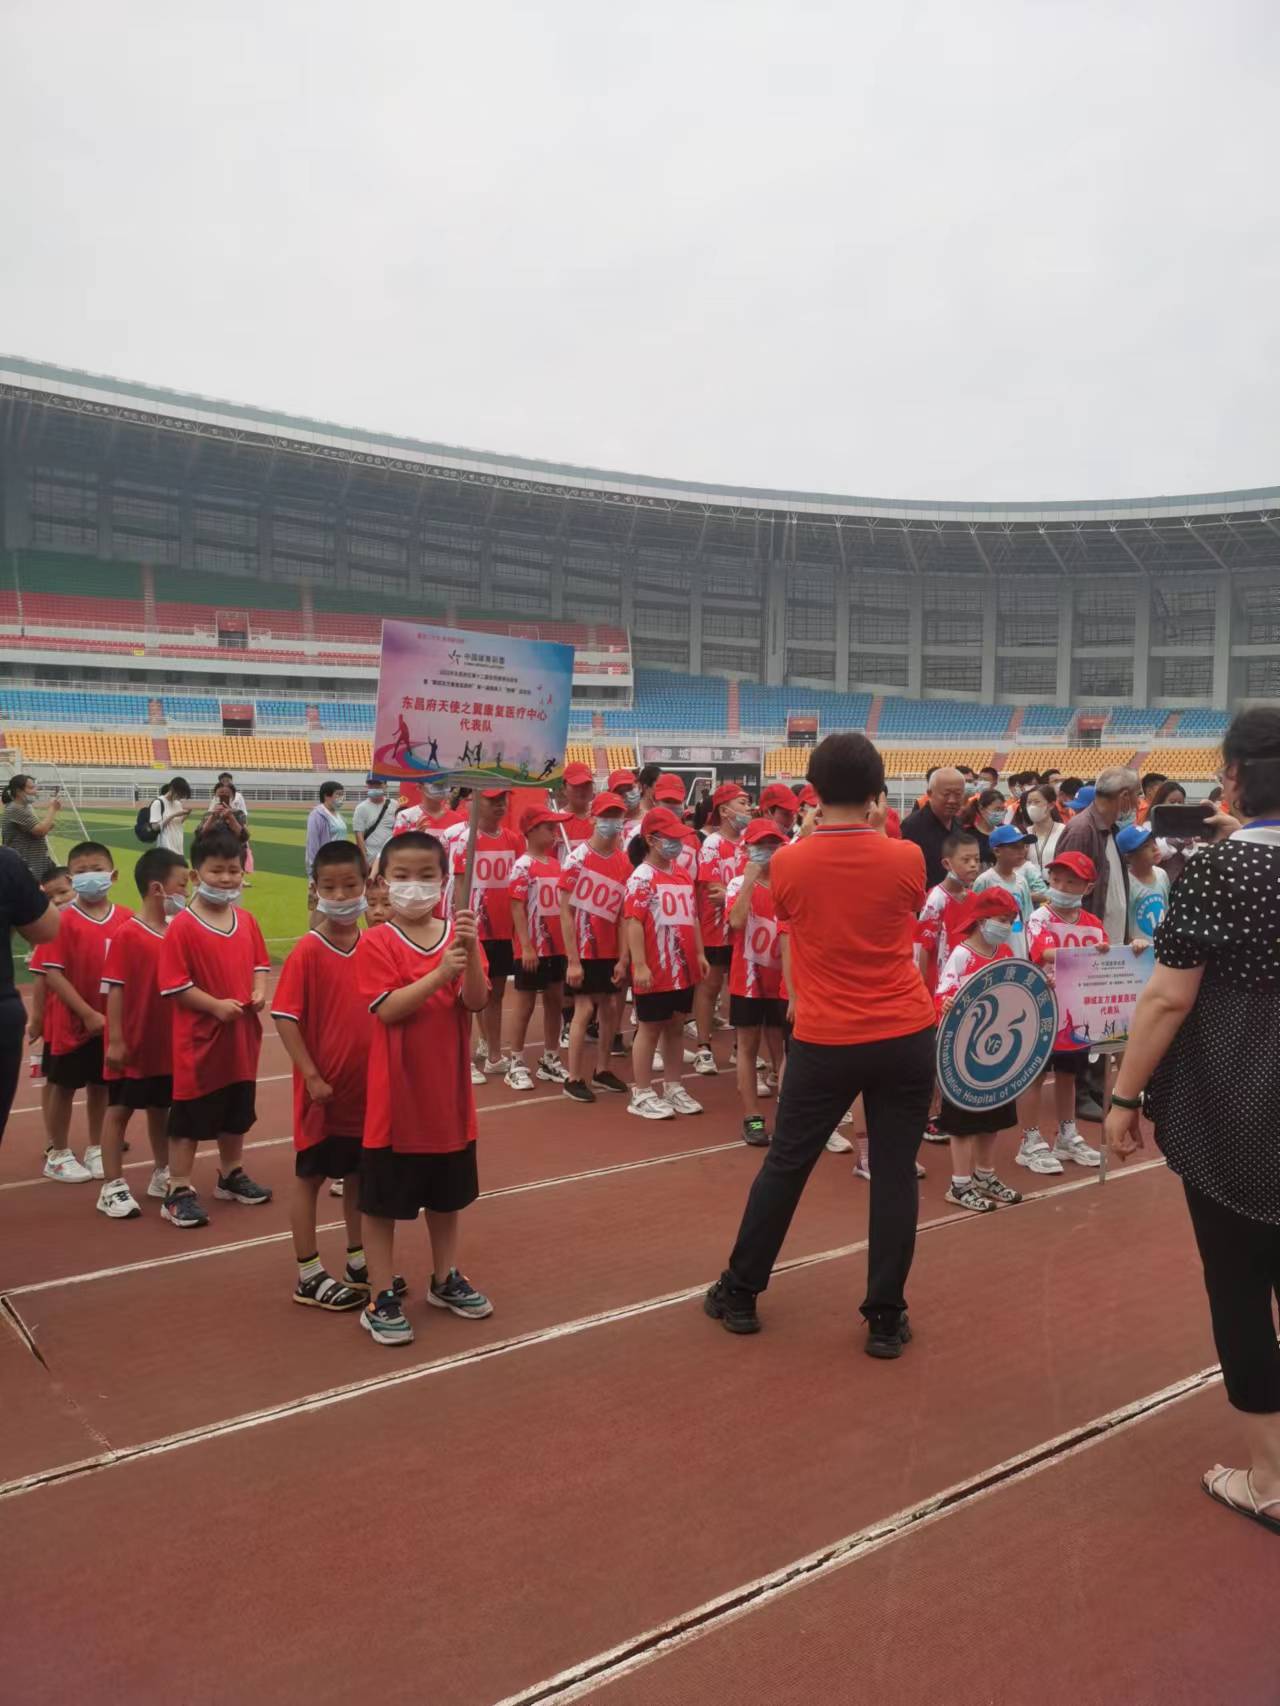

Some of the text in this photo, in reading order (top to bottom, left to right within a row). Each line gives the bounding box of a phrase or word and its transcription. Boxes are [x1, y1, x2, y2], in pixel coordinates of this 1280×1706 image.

[401, 695, 548, 721] 东昌府天使之翼康复医疗中心
[460, 719, 493, 733] 代表队
[575, 876, 622, 915] 002
[985, 1037, 1001, 1052] YF
[962, 1091, 997, 1106] Hospital
[999, 1086, 1009, 1099] of
[1010, 1055, 1044, 1092] Youfang
